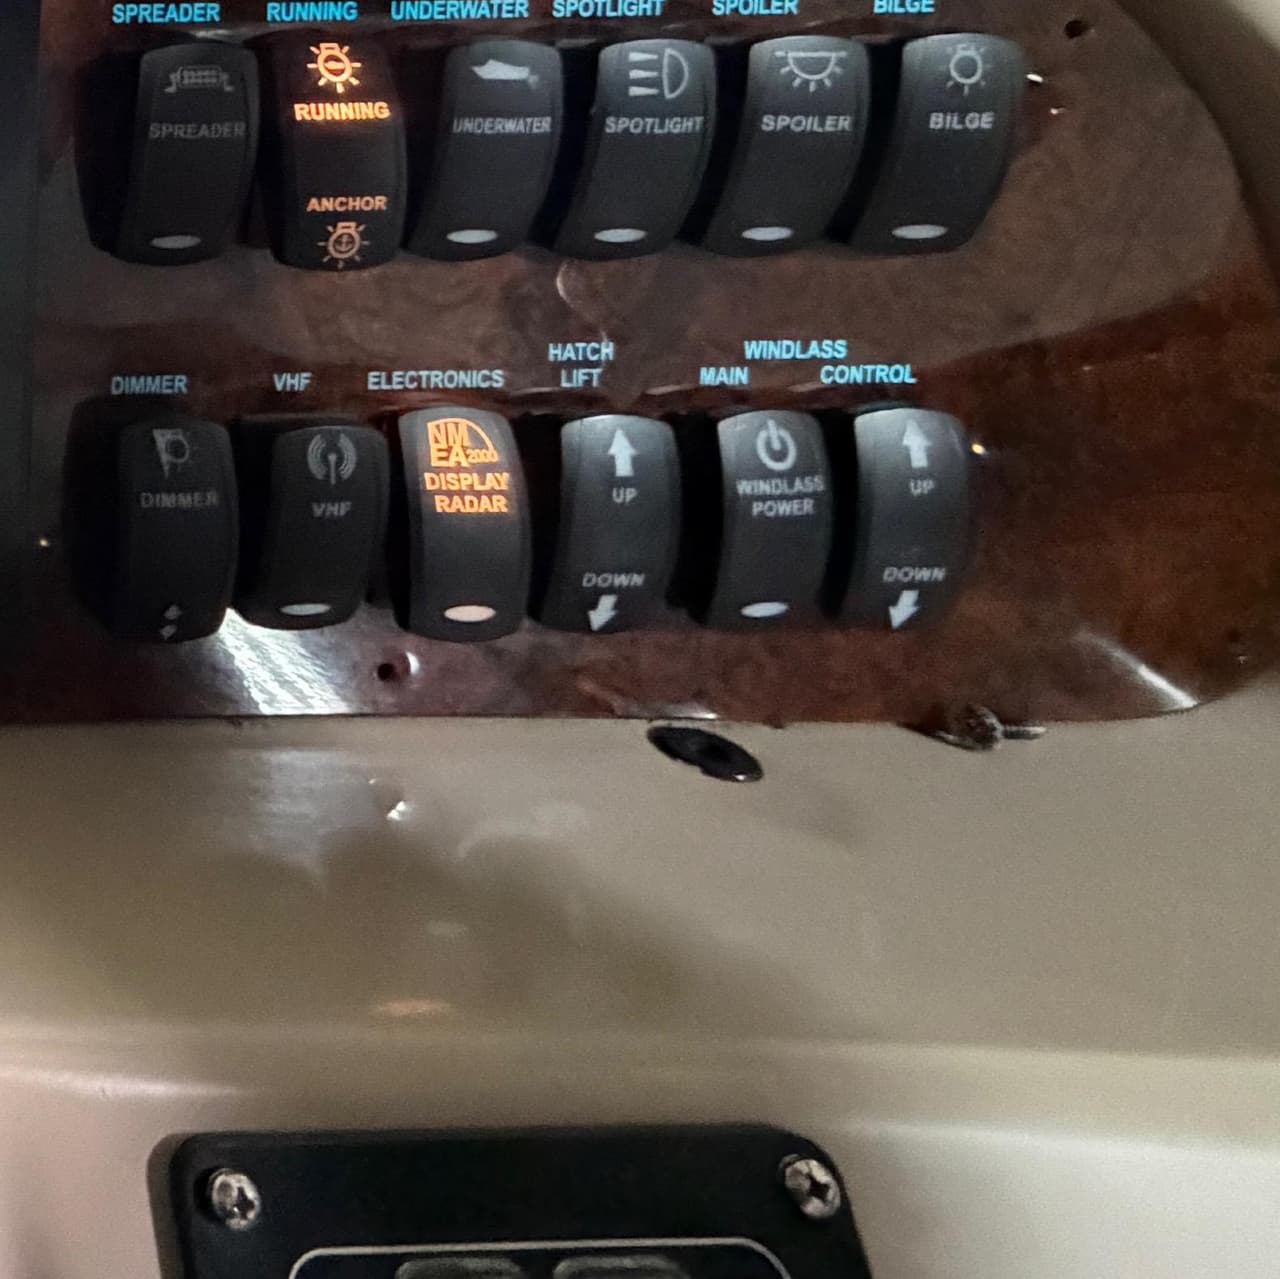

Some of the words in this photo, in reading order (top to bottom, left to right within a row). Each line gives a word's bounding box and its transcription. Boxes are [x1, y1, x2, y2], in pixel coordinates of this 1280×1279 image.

[112, 3, 221, 23] SPREADER
[266, 1, 358, 22] RUNNING
[390, 0, 529, 21] UNDERWATER
[294, 101, 392, 121] RUNNING
[149, 122, 246, 139] SPREADER
[452, 117, 552, 134] UNDERWATER
[605, 116, 705, 134] SPOTLIGHT
[761, 114, 853, 133] SPOILER
[929, 112, 996, 131] BILGE
[306, 196, 388, 212] ANCHOR
[548, 342, 615, 362] HATCH
[744, 340, 847, 360] WINDLASS
[273, 372, 312, 392] VHF
[367, 369, 505, 390] ELECTRONICS
[560, 368, 602, 388] LIFT
[699, 366, 749, 385] MAIN
[820, 365, 916, 384] CONTROL
[111, 375, 188, 395] DIMMER
[424, 472, 509, 490] DISPLAY
[736, 475, 825, 495] WINDLASS
[909, 479, 935, 496] UP
[140, 491, 219, 509] DIMMER
[434, 495, 508, 512] RADAR
[612, 487, 637, 504] UP
[312, 501, 352, 517] VHF
[752, 499, 815, 517] POWER
[582, 572, 646, 588] DOWN
[882, 566, 946, 582] DOWN
